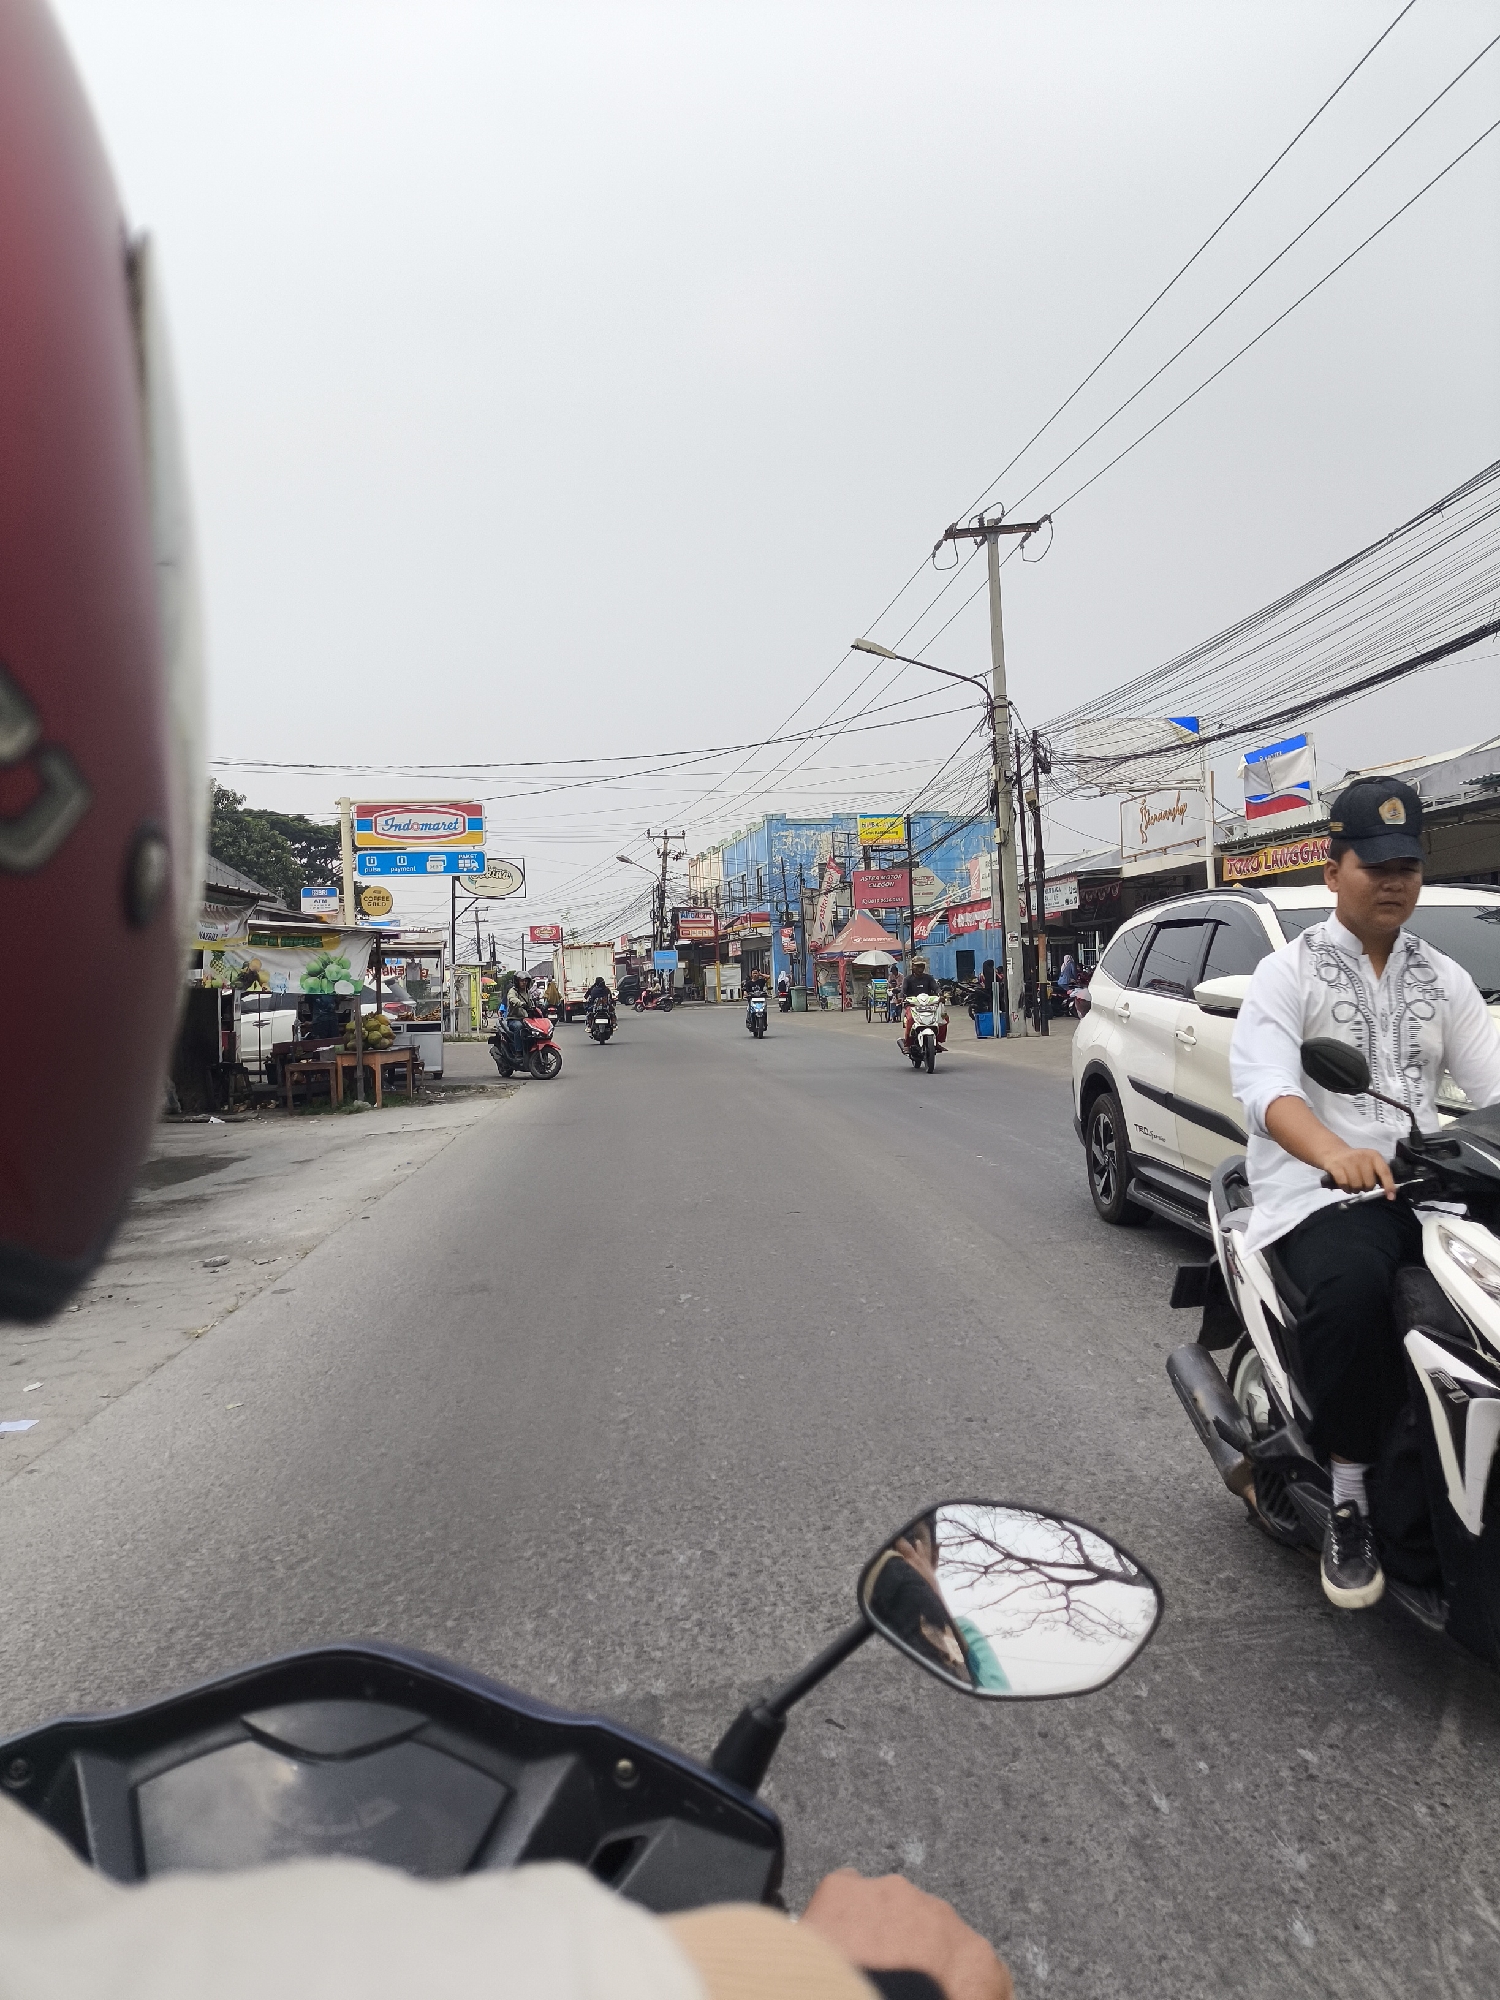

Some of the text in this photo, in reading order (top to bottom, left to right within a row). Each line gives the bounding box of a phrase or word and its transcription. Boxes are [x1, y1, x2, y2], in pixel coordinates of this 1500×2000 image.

[381, 816, 460, 832] Indomaret
[390, 864, 417, 873] payment
[1226, 855, 1261, 877] TOKO
[880, 873, 903, 881] MOTOR
